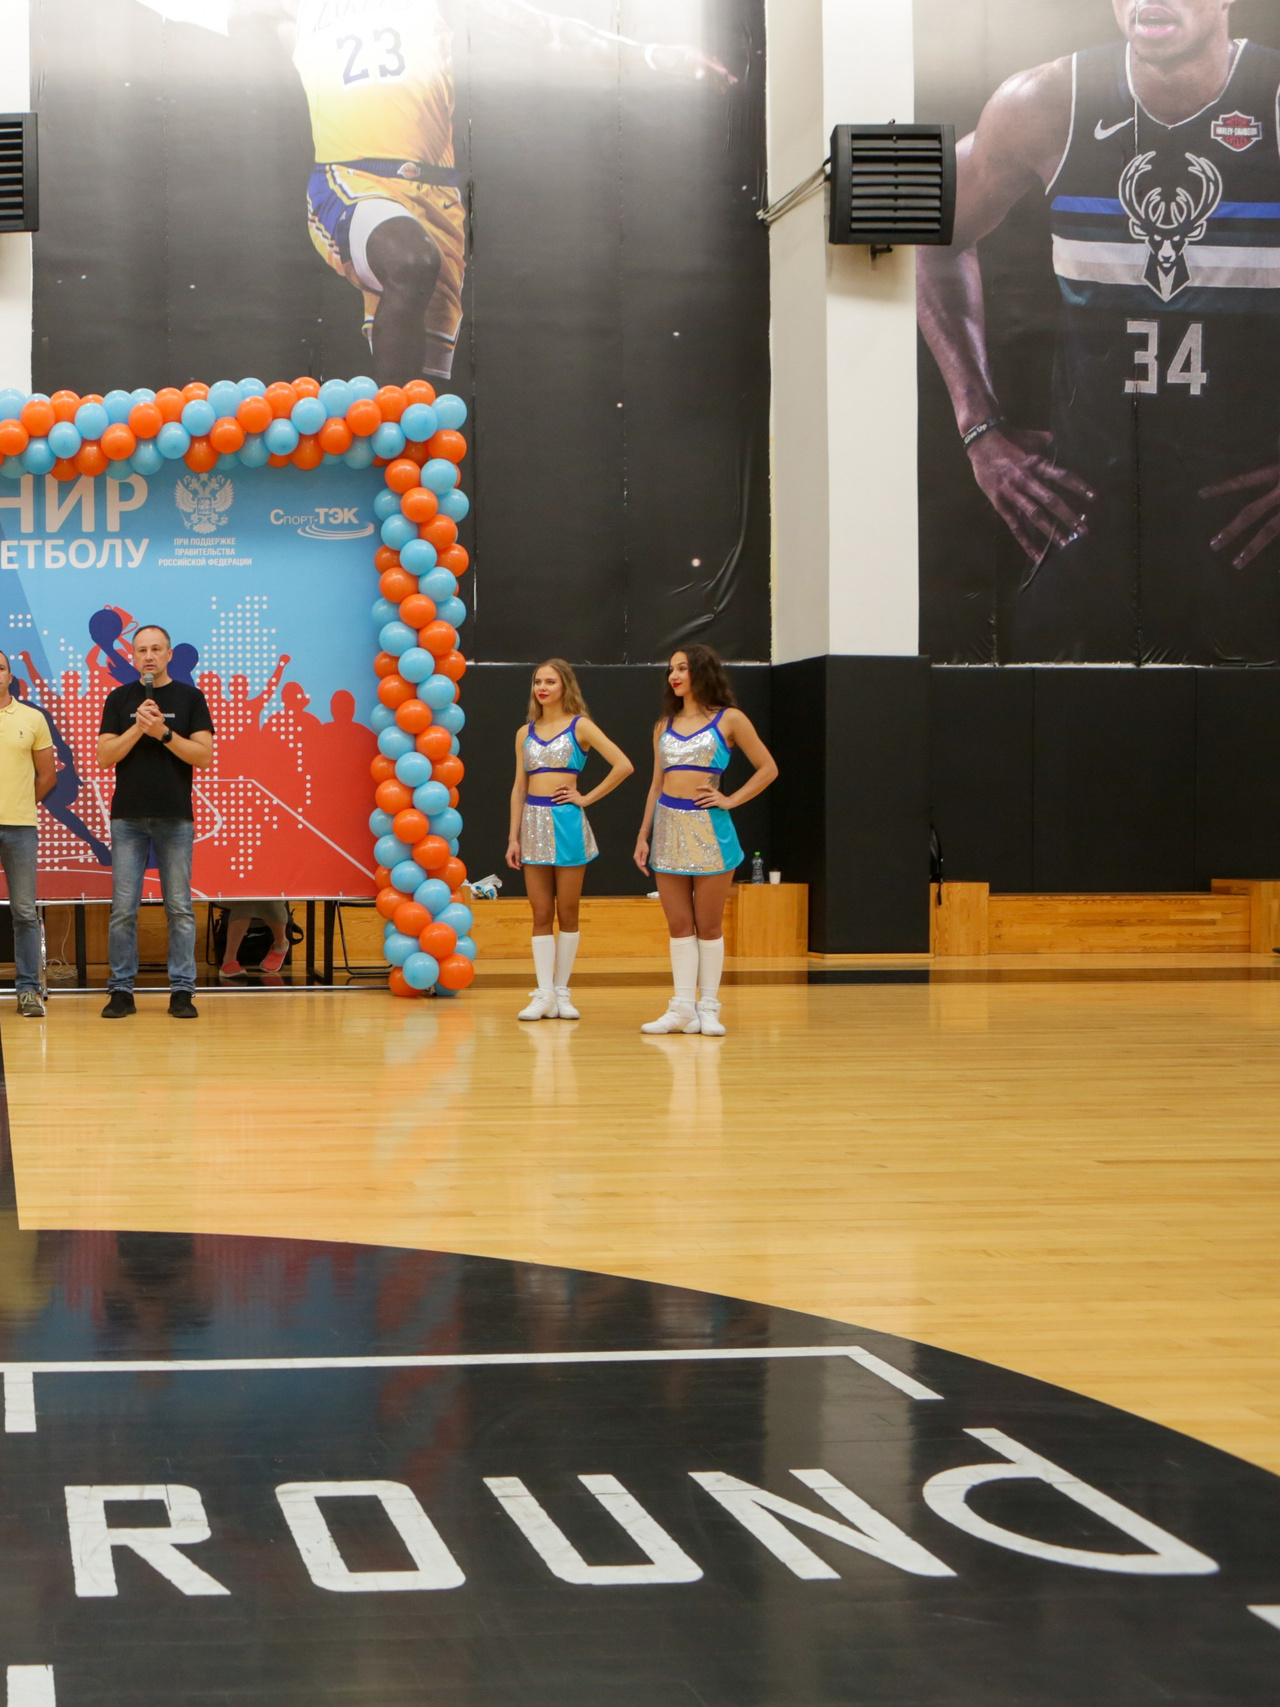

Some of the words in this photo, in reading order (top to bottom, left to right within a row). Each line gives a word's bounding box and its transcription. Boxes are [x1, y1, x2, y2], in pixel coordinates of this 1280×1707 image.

[335, 26, 407, 86] 23
[1124, 319, 1208, 396] 34
[174, 537, 189, 546] ПРИ
[190, 537, 236, 546] ПОДДЕРЖКЕ
[174, 547, 236, 556] ПРАВИТЕЛЬСТВА
[158, 557, 206, 567] РОССИЙСКОЙ
[207, 557, 253, 567] ФЕДЕРАЦИИ
